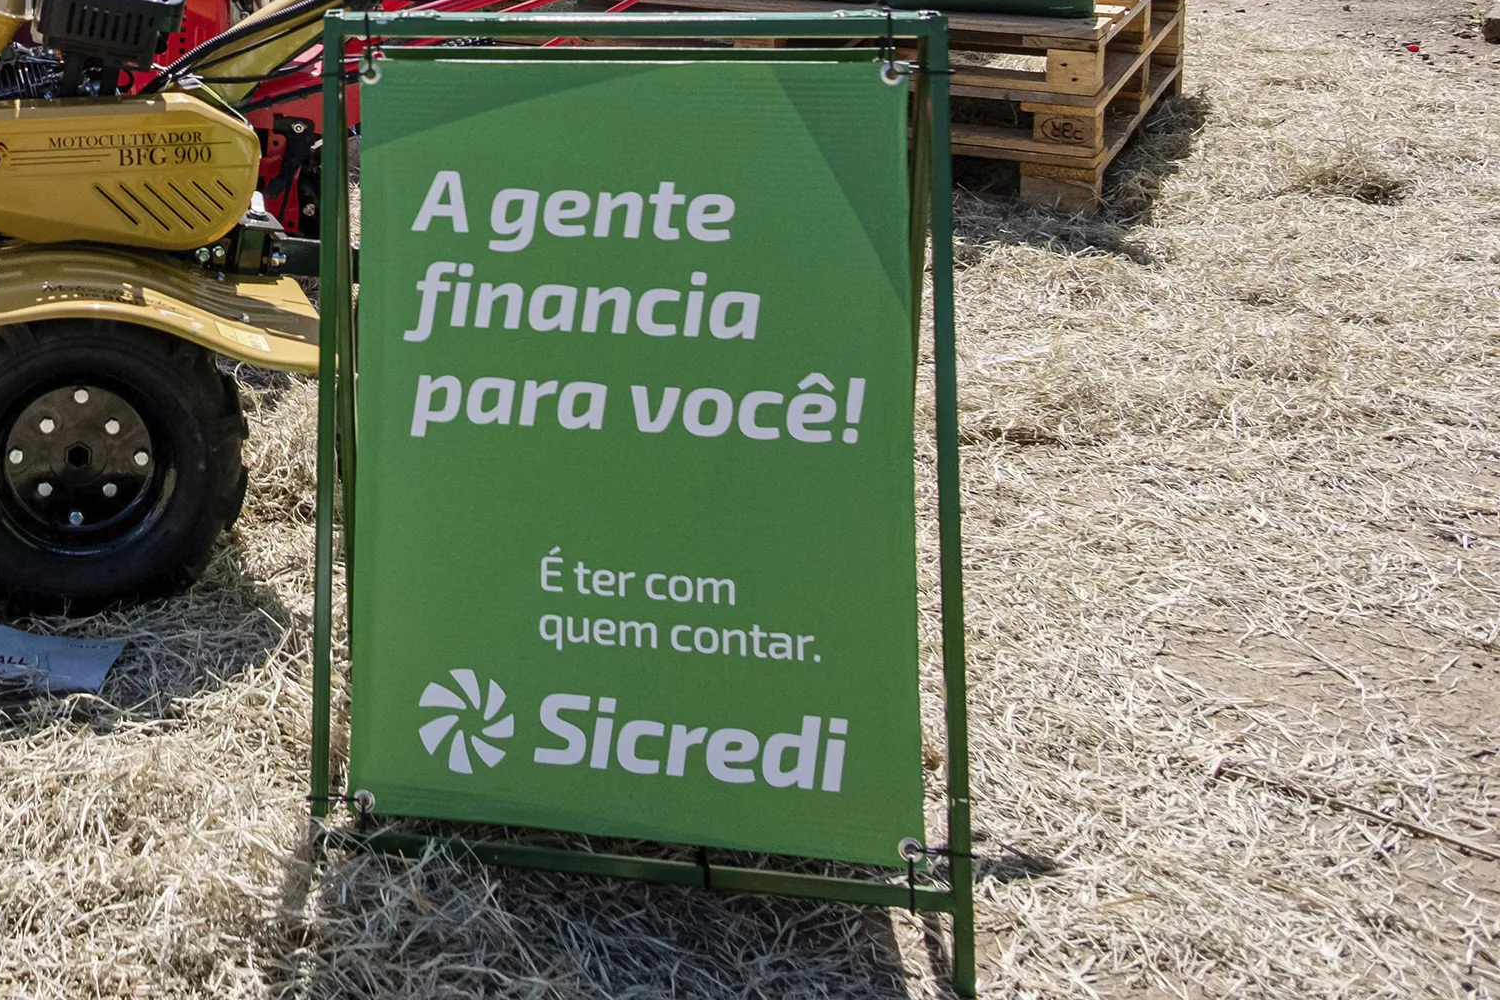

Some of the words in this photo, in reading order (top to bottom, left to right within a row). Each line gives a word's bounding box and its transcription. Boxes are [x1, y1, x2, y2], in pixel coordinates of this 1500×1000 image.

[48, 131, 203, 149] MOTOCULTIVADOR
[119, 148, 168, 167] BFG
[174, 146, 212, 164] 900
[411, 170, 470, 233] A
[491, 181, 736, 252] gente
[405, 261, 761, 342] financia
[410, 374, 607, 438] para
[631, 373, 866, 445] você!
[539, 546, 564, 593] É
[574, 559, 636, 599] ter
[645, 571, 736, 605] com
[538, 614, 659, 651] quem
[669, 619, 822, 664] contar.
[534, 693, 850, 793] Sicredi
